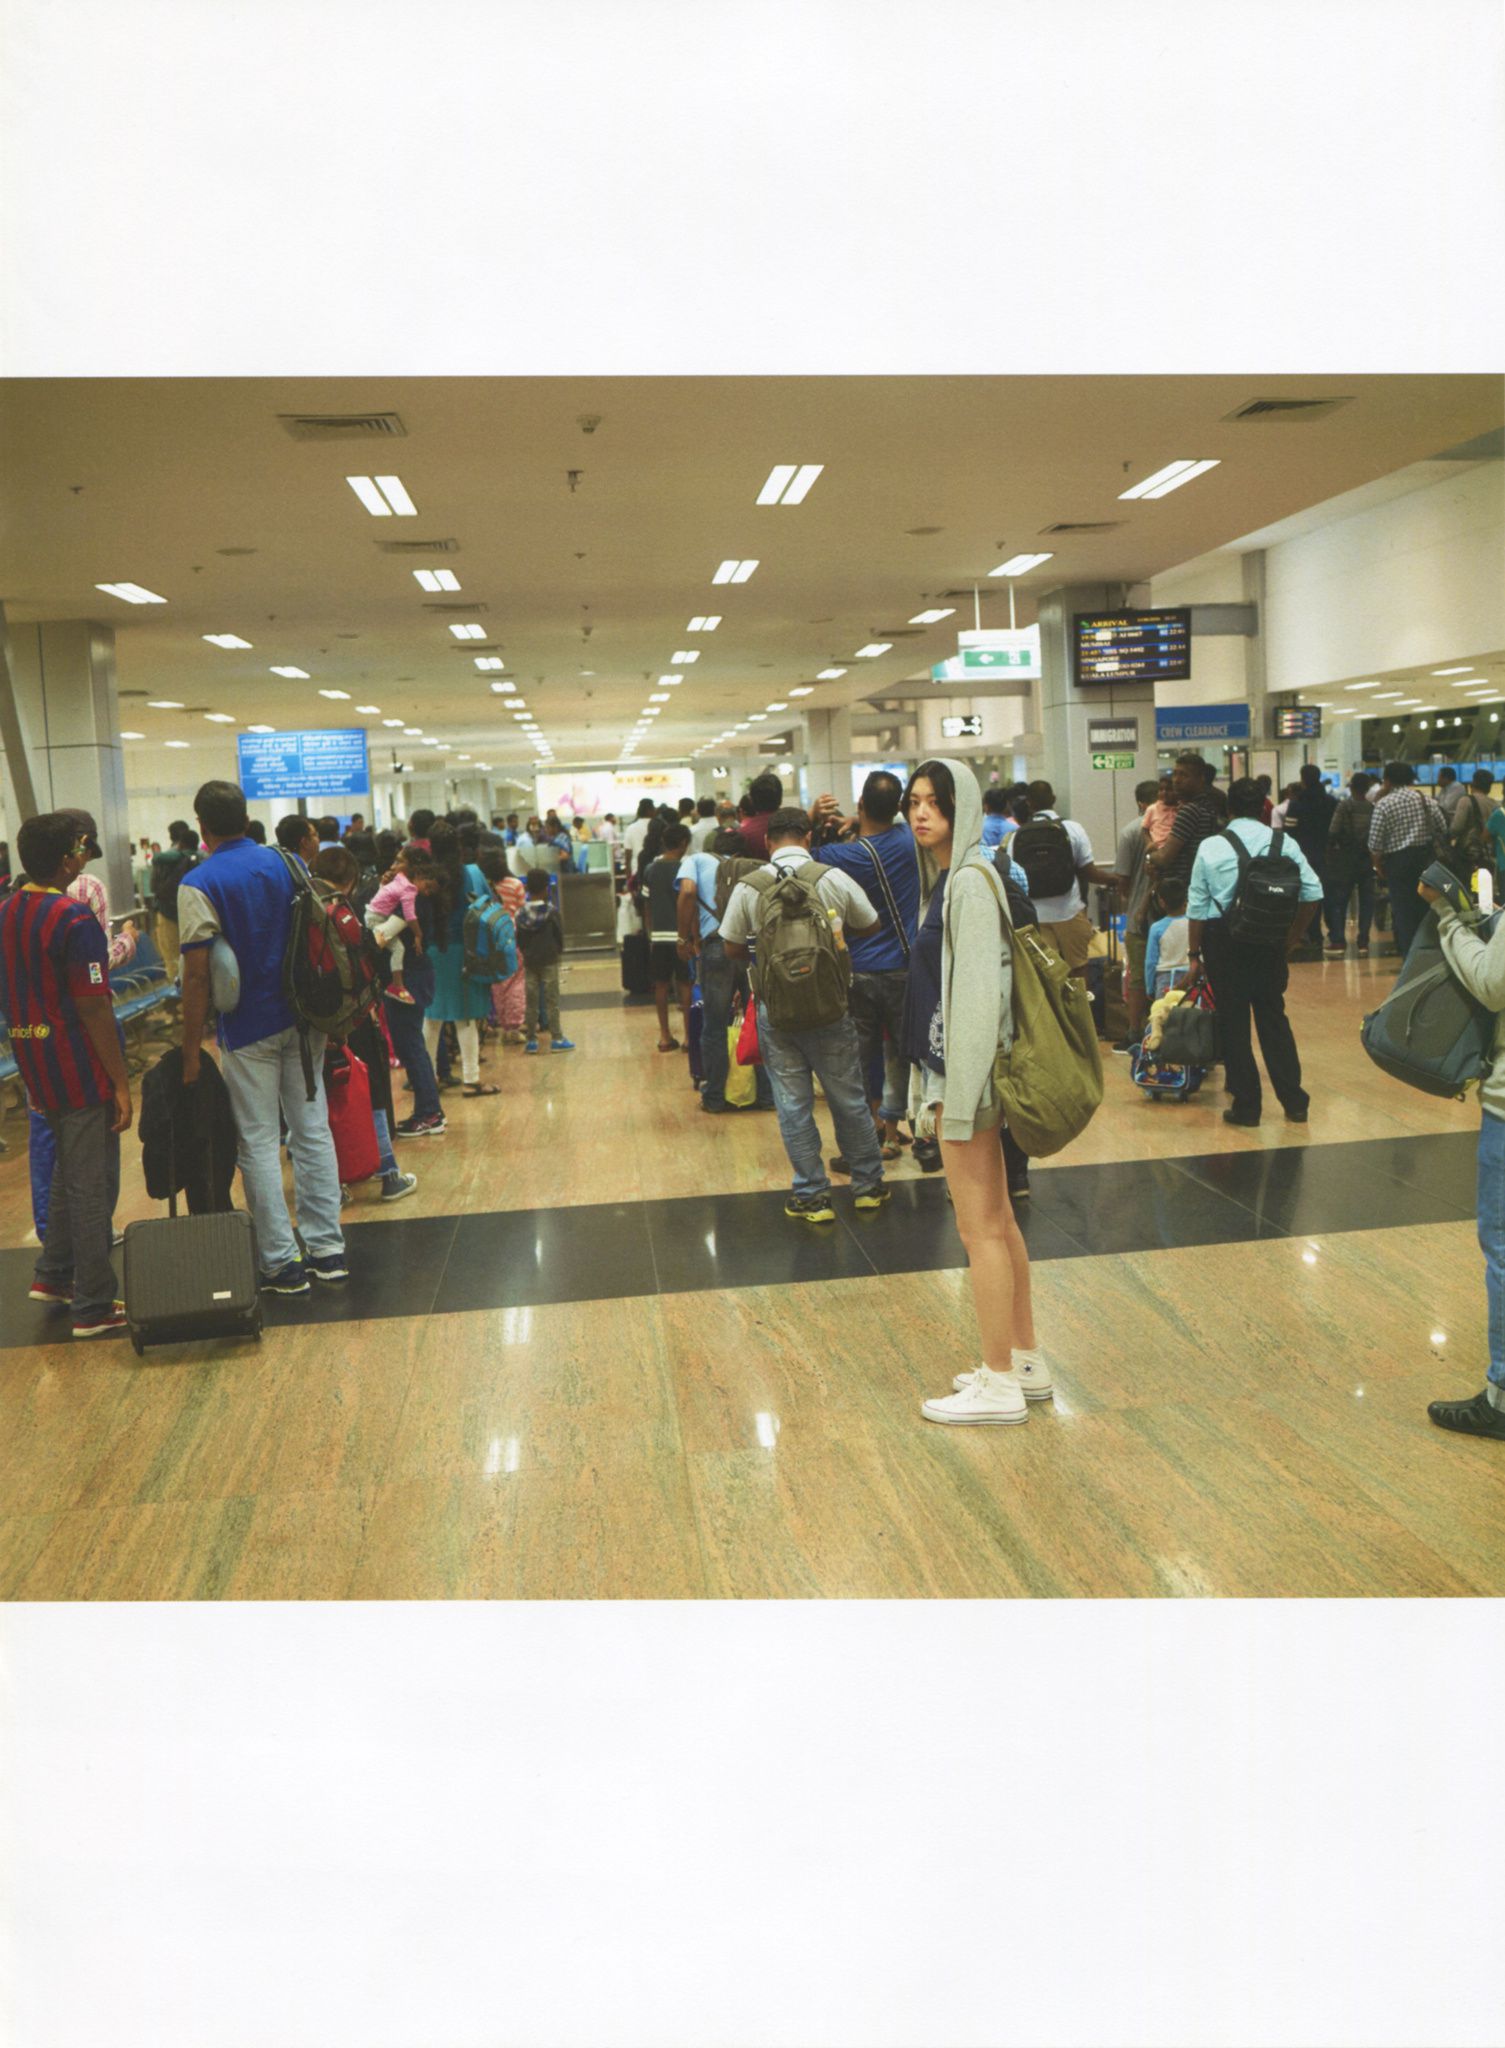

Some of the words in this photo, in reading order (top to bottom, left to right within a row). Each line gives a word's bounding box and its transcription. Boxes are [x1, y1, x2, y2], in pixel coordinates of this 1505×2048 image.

[1090, 728, 1136, 743] IMMIGRATION
[1161, 727, 1183, 738] CREW
[1184, 725, 1229, 737] CLEARANCE
[1115, 760, 1133, 768] EXIT
[7, 1024, 33, 1039] unicef
